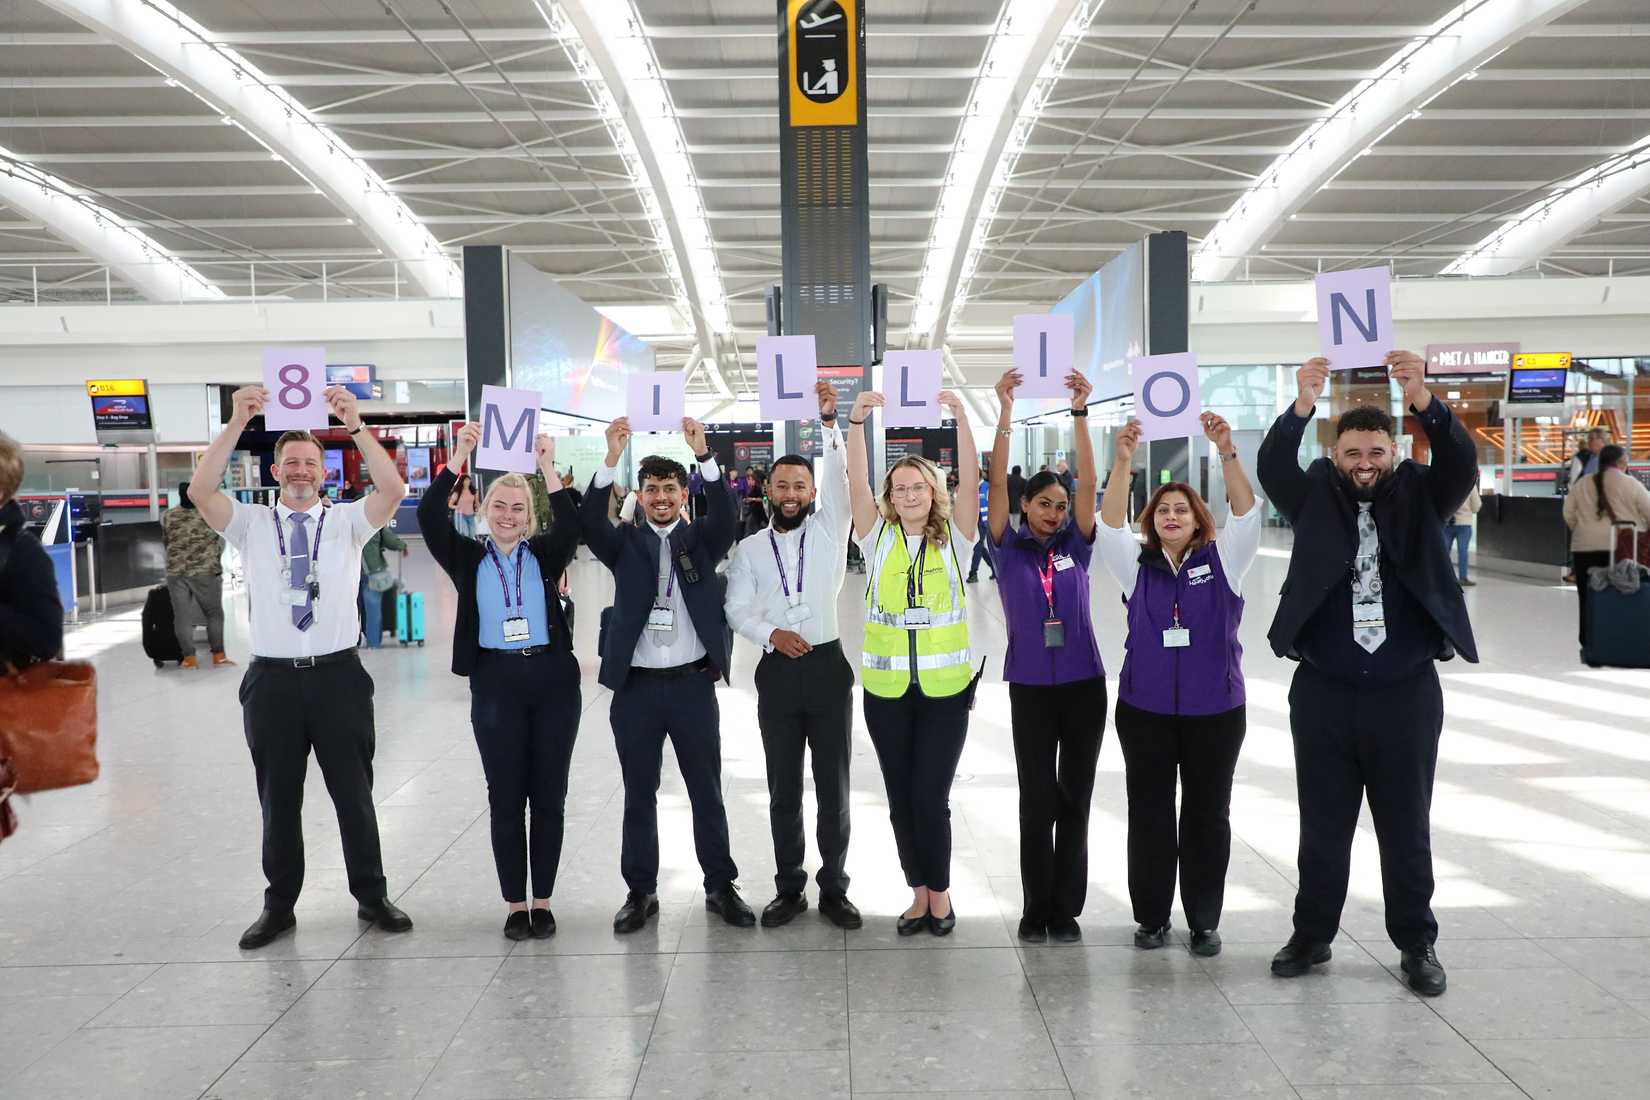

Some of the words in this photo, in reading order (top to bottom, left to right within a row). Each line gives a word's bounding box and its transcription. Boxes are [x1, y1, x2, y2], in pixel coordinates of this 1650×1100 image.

[1330, 288, 1379, 346] N
[775, 353, 804, 400] L
[1039, 331, 1048, 378] I
[277, 363, 312, 410] 8
[652, 384, 661, 416] I
[900, 365, 927, 408] L
[1142, 370, 1191, 418] O
[481, 402, 537, 454] M
